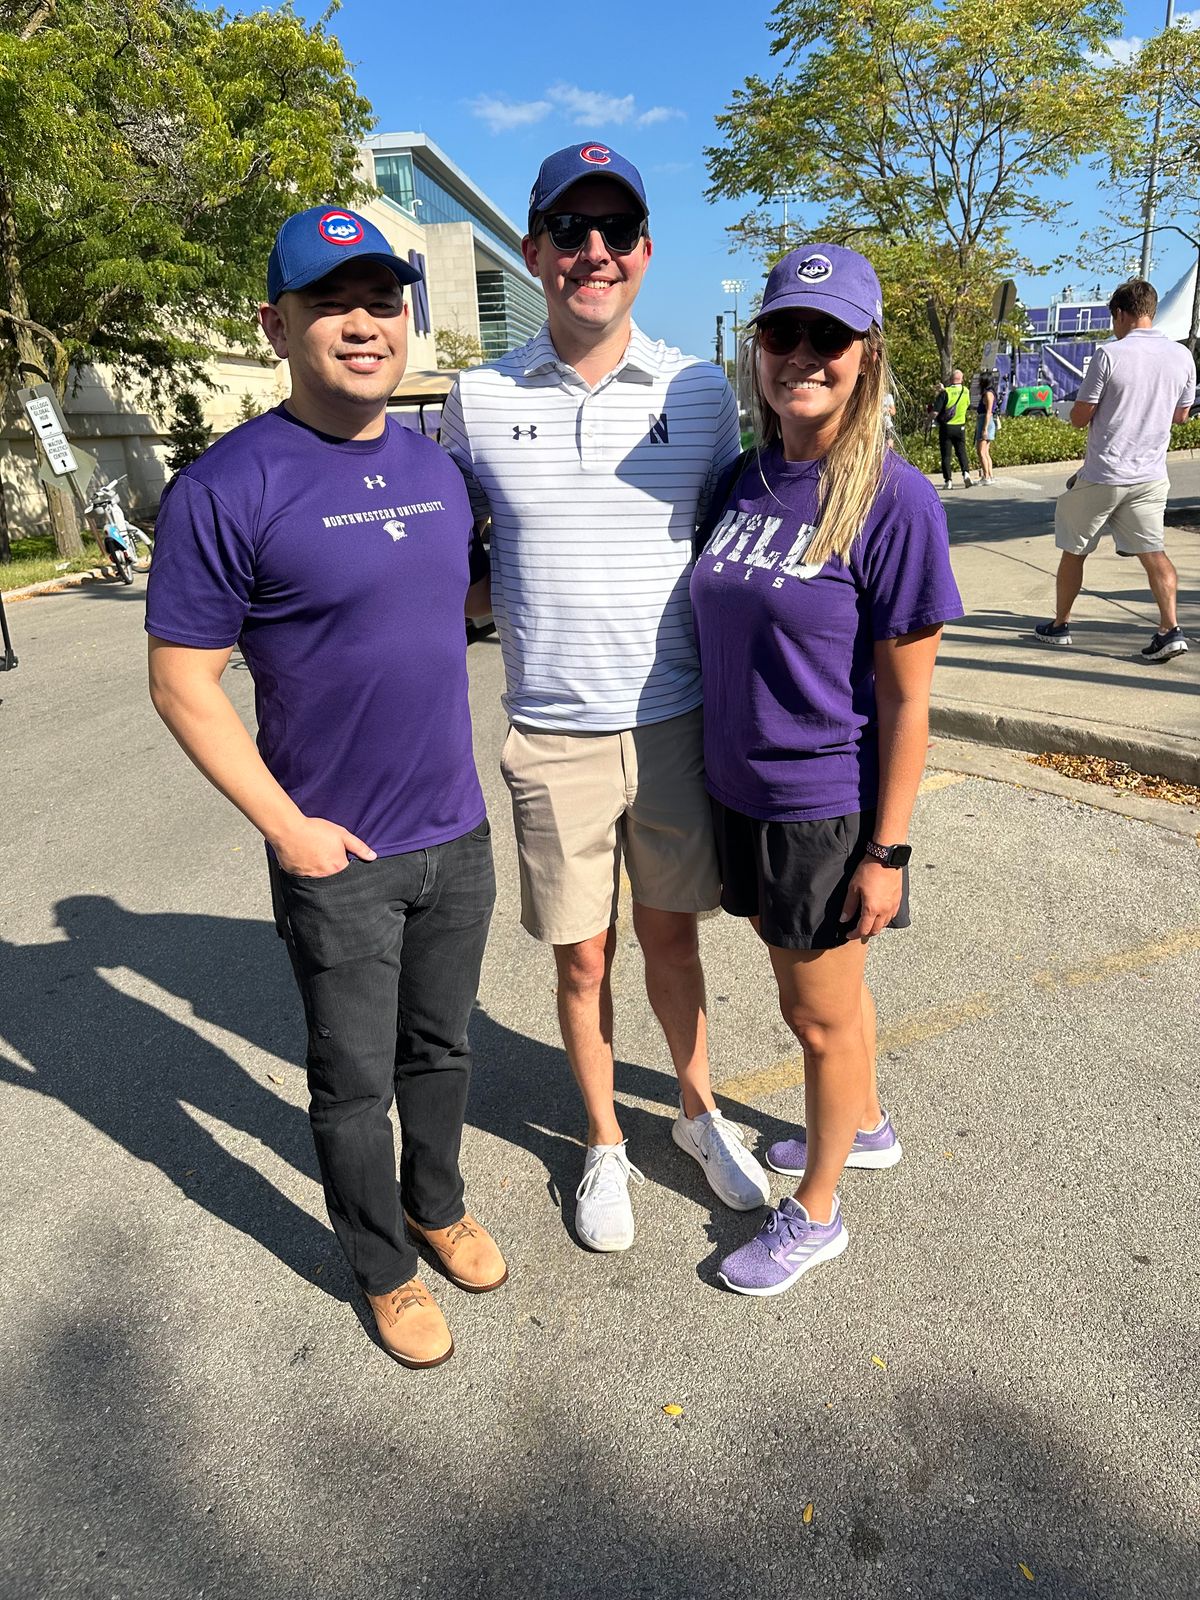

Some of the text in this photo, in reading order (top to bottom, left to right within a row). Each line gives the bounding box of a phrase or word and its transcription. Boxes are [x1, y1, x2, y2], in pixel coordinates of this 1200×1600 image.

[579, 144, 611, 165] C
[648, 413, 669, 444] N
[322, 501, 444, 528] NORTHWESTERN UNIVERSITY
